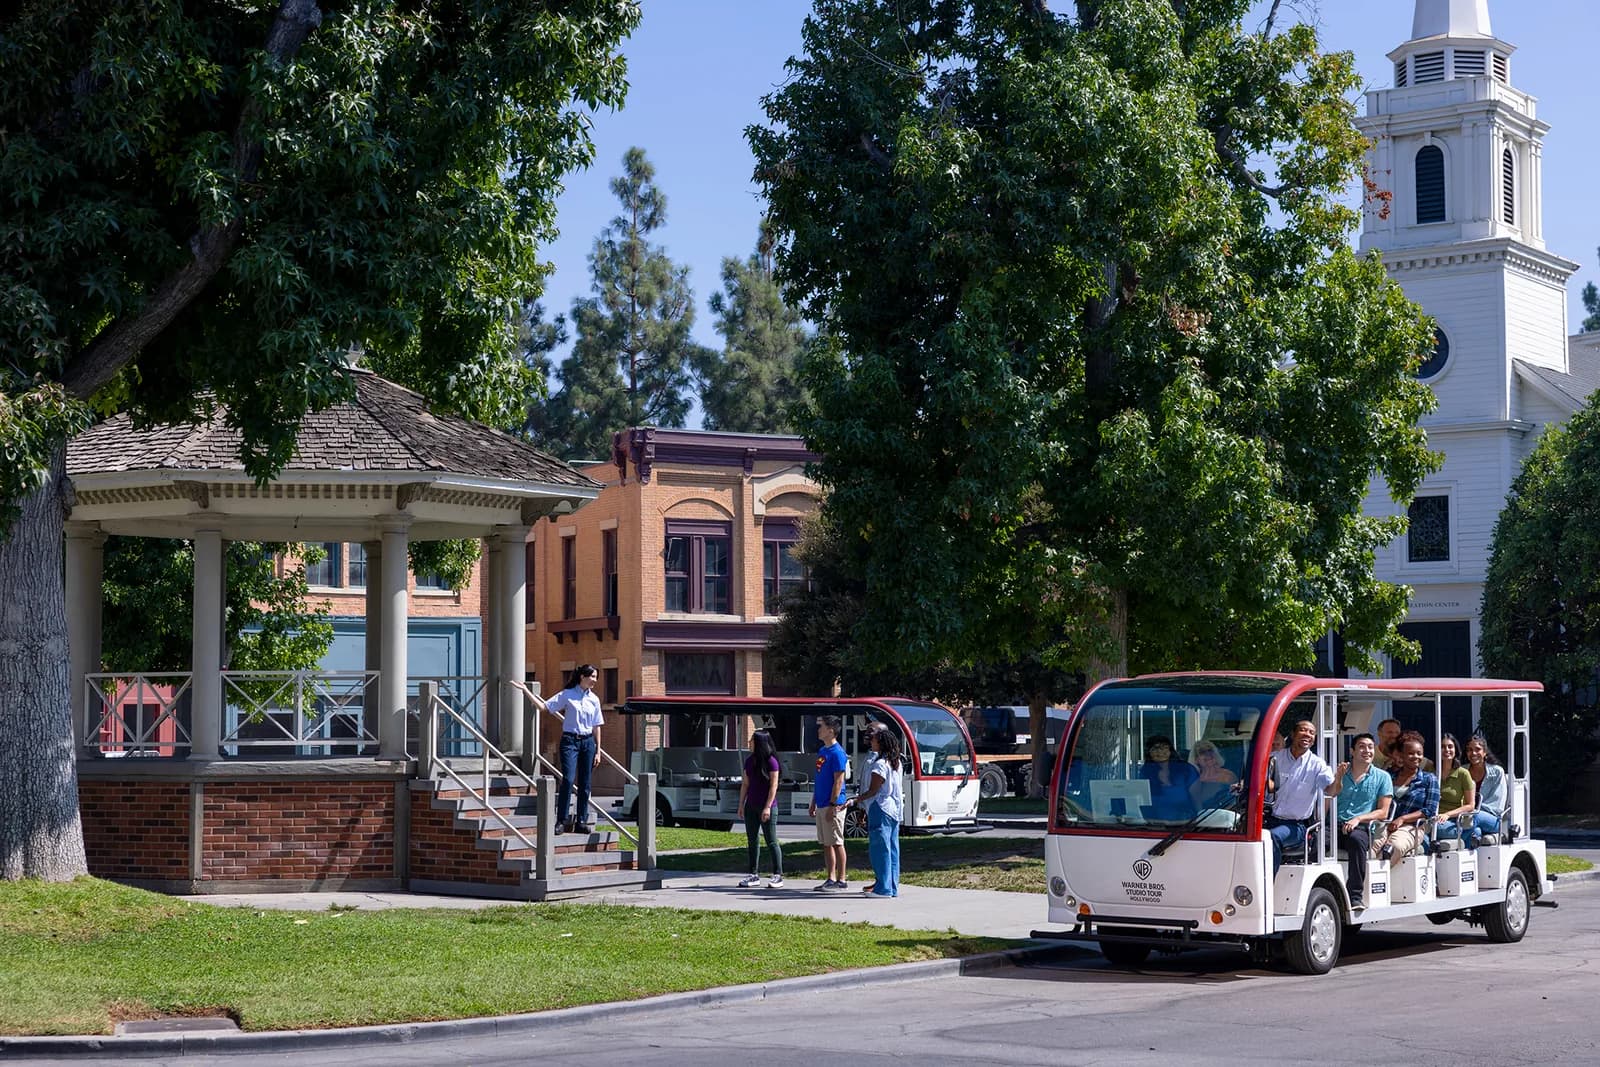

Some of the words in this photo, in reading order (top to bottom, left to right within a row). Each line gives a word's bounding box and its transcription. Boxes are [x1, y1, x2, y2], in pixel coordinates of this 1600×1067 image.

[1434, 601, 1460, 609] CENTER
[1134, 862, 1150, 877] WB
[1121, 881, 1147, 889] WARNER
